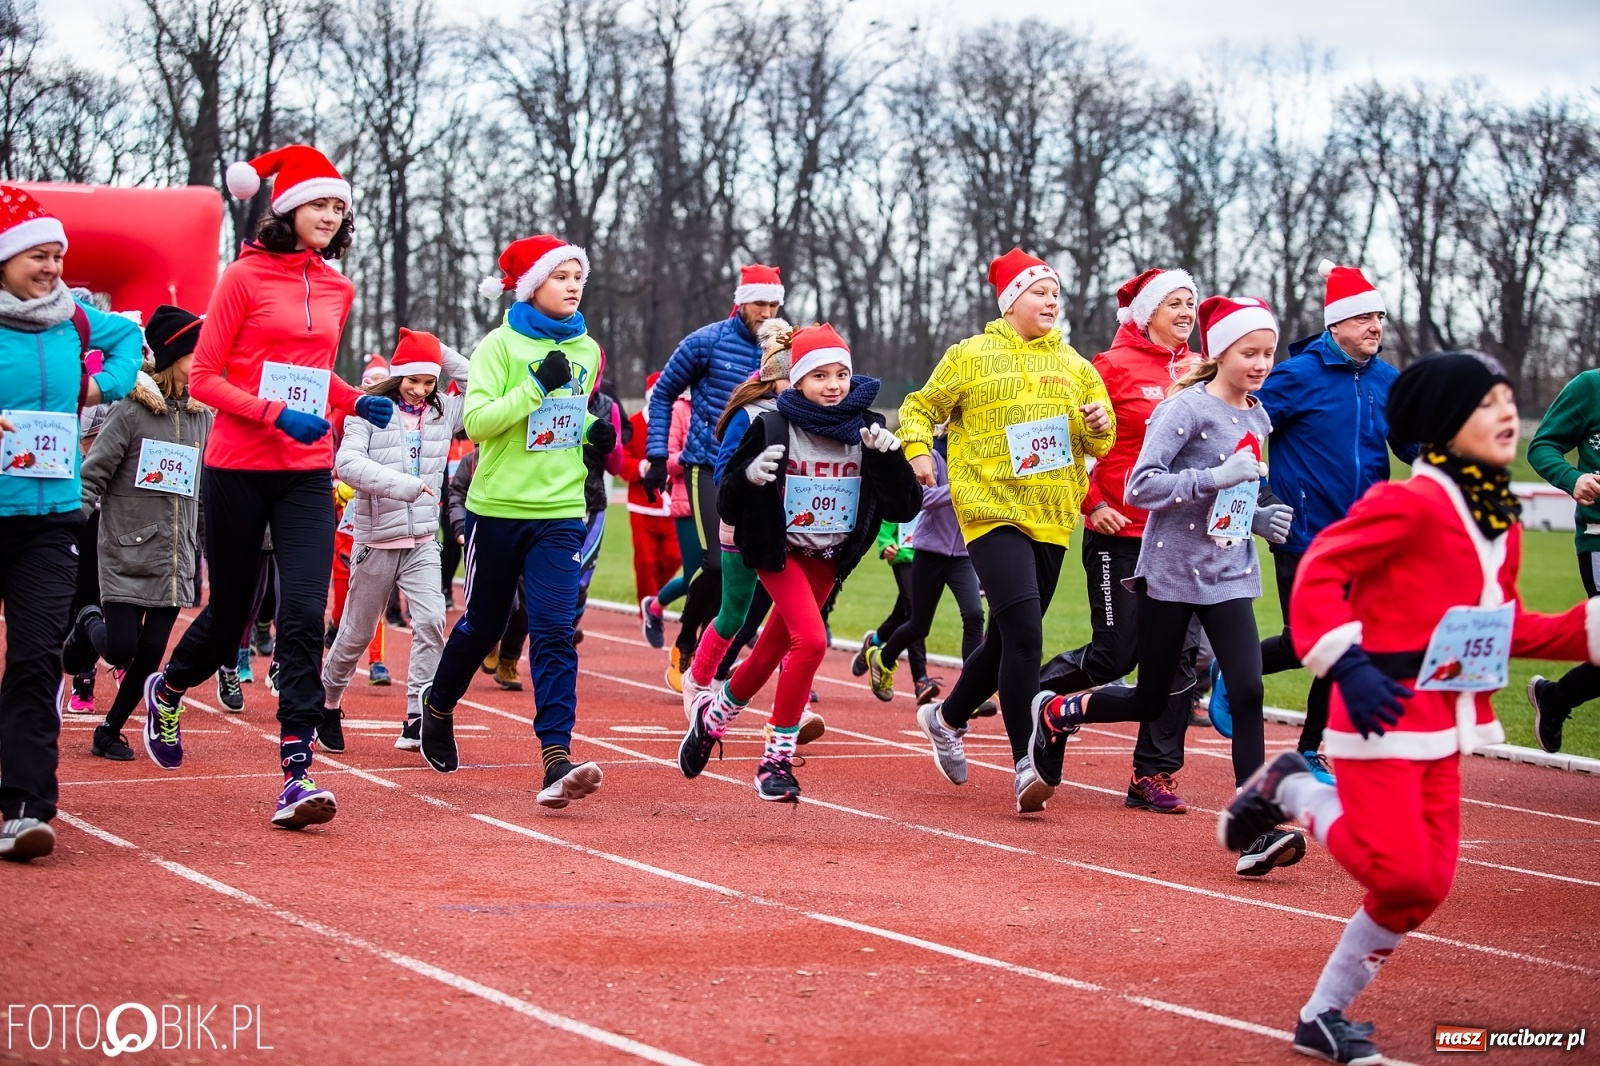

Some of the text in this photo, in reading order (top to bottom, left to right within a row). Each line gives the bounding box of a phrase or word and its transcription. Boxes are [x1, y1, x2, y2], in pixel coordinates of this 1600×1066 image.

[287, 386, 308, 402] 151
[552, 415, 571, 429] 147
[34, 435, 57, 452] 121
[1032, 435, 1057, 452] 034
[160, 458, 183, 473] 054
[811, 496, 837, 511] 091
[1230, 499, 1247, 515] 087
[1097, 551, 1115, 627] smsraciborz.pl
[1462, 637, 1495, 659] 155
